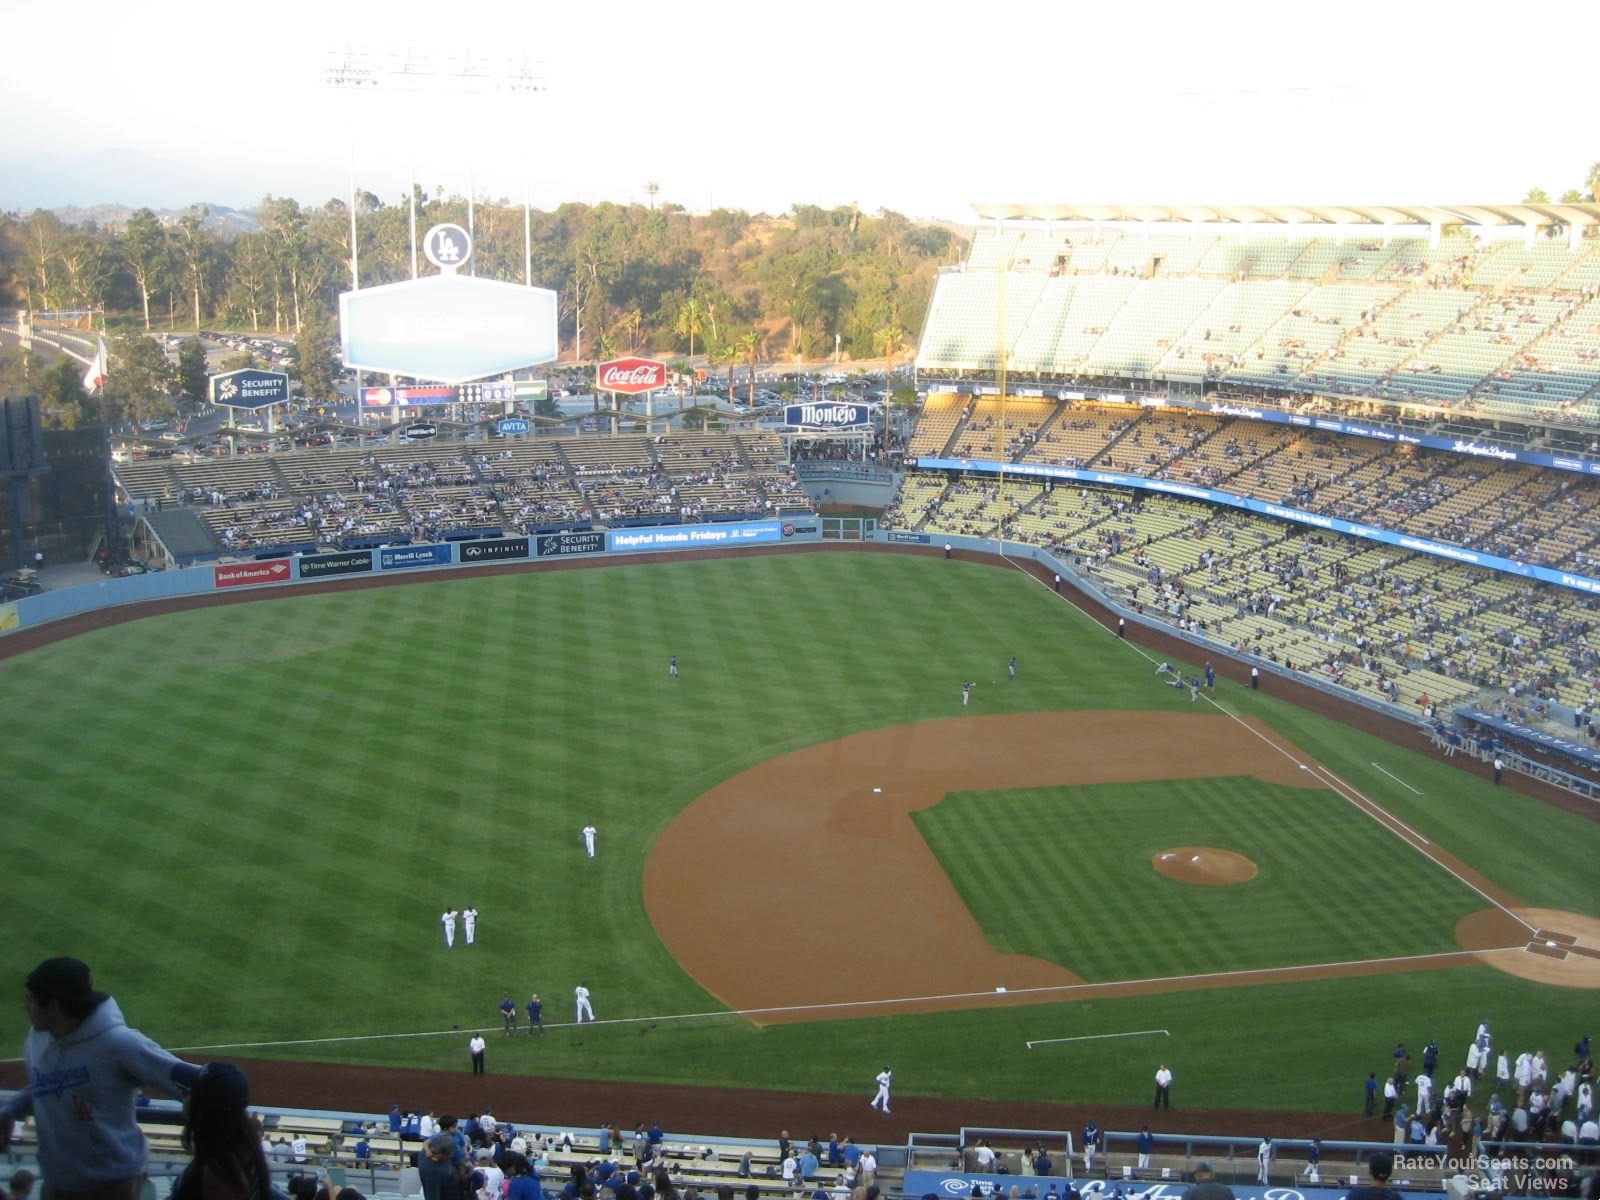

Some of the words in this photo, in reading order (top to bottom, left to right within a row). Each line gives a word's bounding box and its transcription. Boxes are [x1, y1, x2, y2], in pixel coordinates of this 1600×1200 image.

[437, 231, 460, 261] LA
[603, 365, 660, 385] Coca-Cola
[241, 379, 283, 388] SECURITY
[241, 388, 280, 397] BENEFIT
[800, 404, 857, 425] Montejo
[501, 421, 527, 431] AVITA
[1489, 446, 1517, 460] Dodgers
[560, 534, 600, 544] SECURITY
[615, 535, 653, 545] Helpful
[655, 533, 688, 542] Honda
[690, 531, 727, 541] Fridays
[483, 545, 524, 554] INFINITI
[560, 544, 597, 553] BENEFIT
[394, 552, 414, 560] Merrill
[415, 550, 433, 559] Lynch
[310, 562, 326, 570] Time
[326, 560, 350, 568] Warner
[350, 557, 370, 566] Cable
[218, 572, 236, 580] Bank
[243, 569, 270, 577] America
[1503, 721, 1588, 752] STADIUM
[31, 1064, 91, 1098] Dodgers
